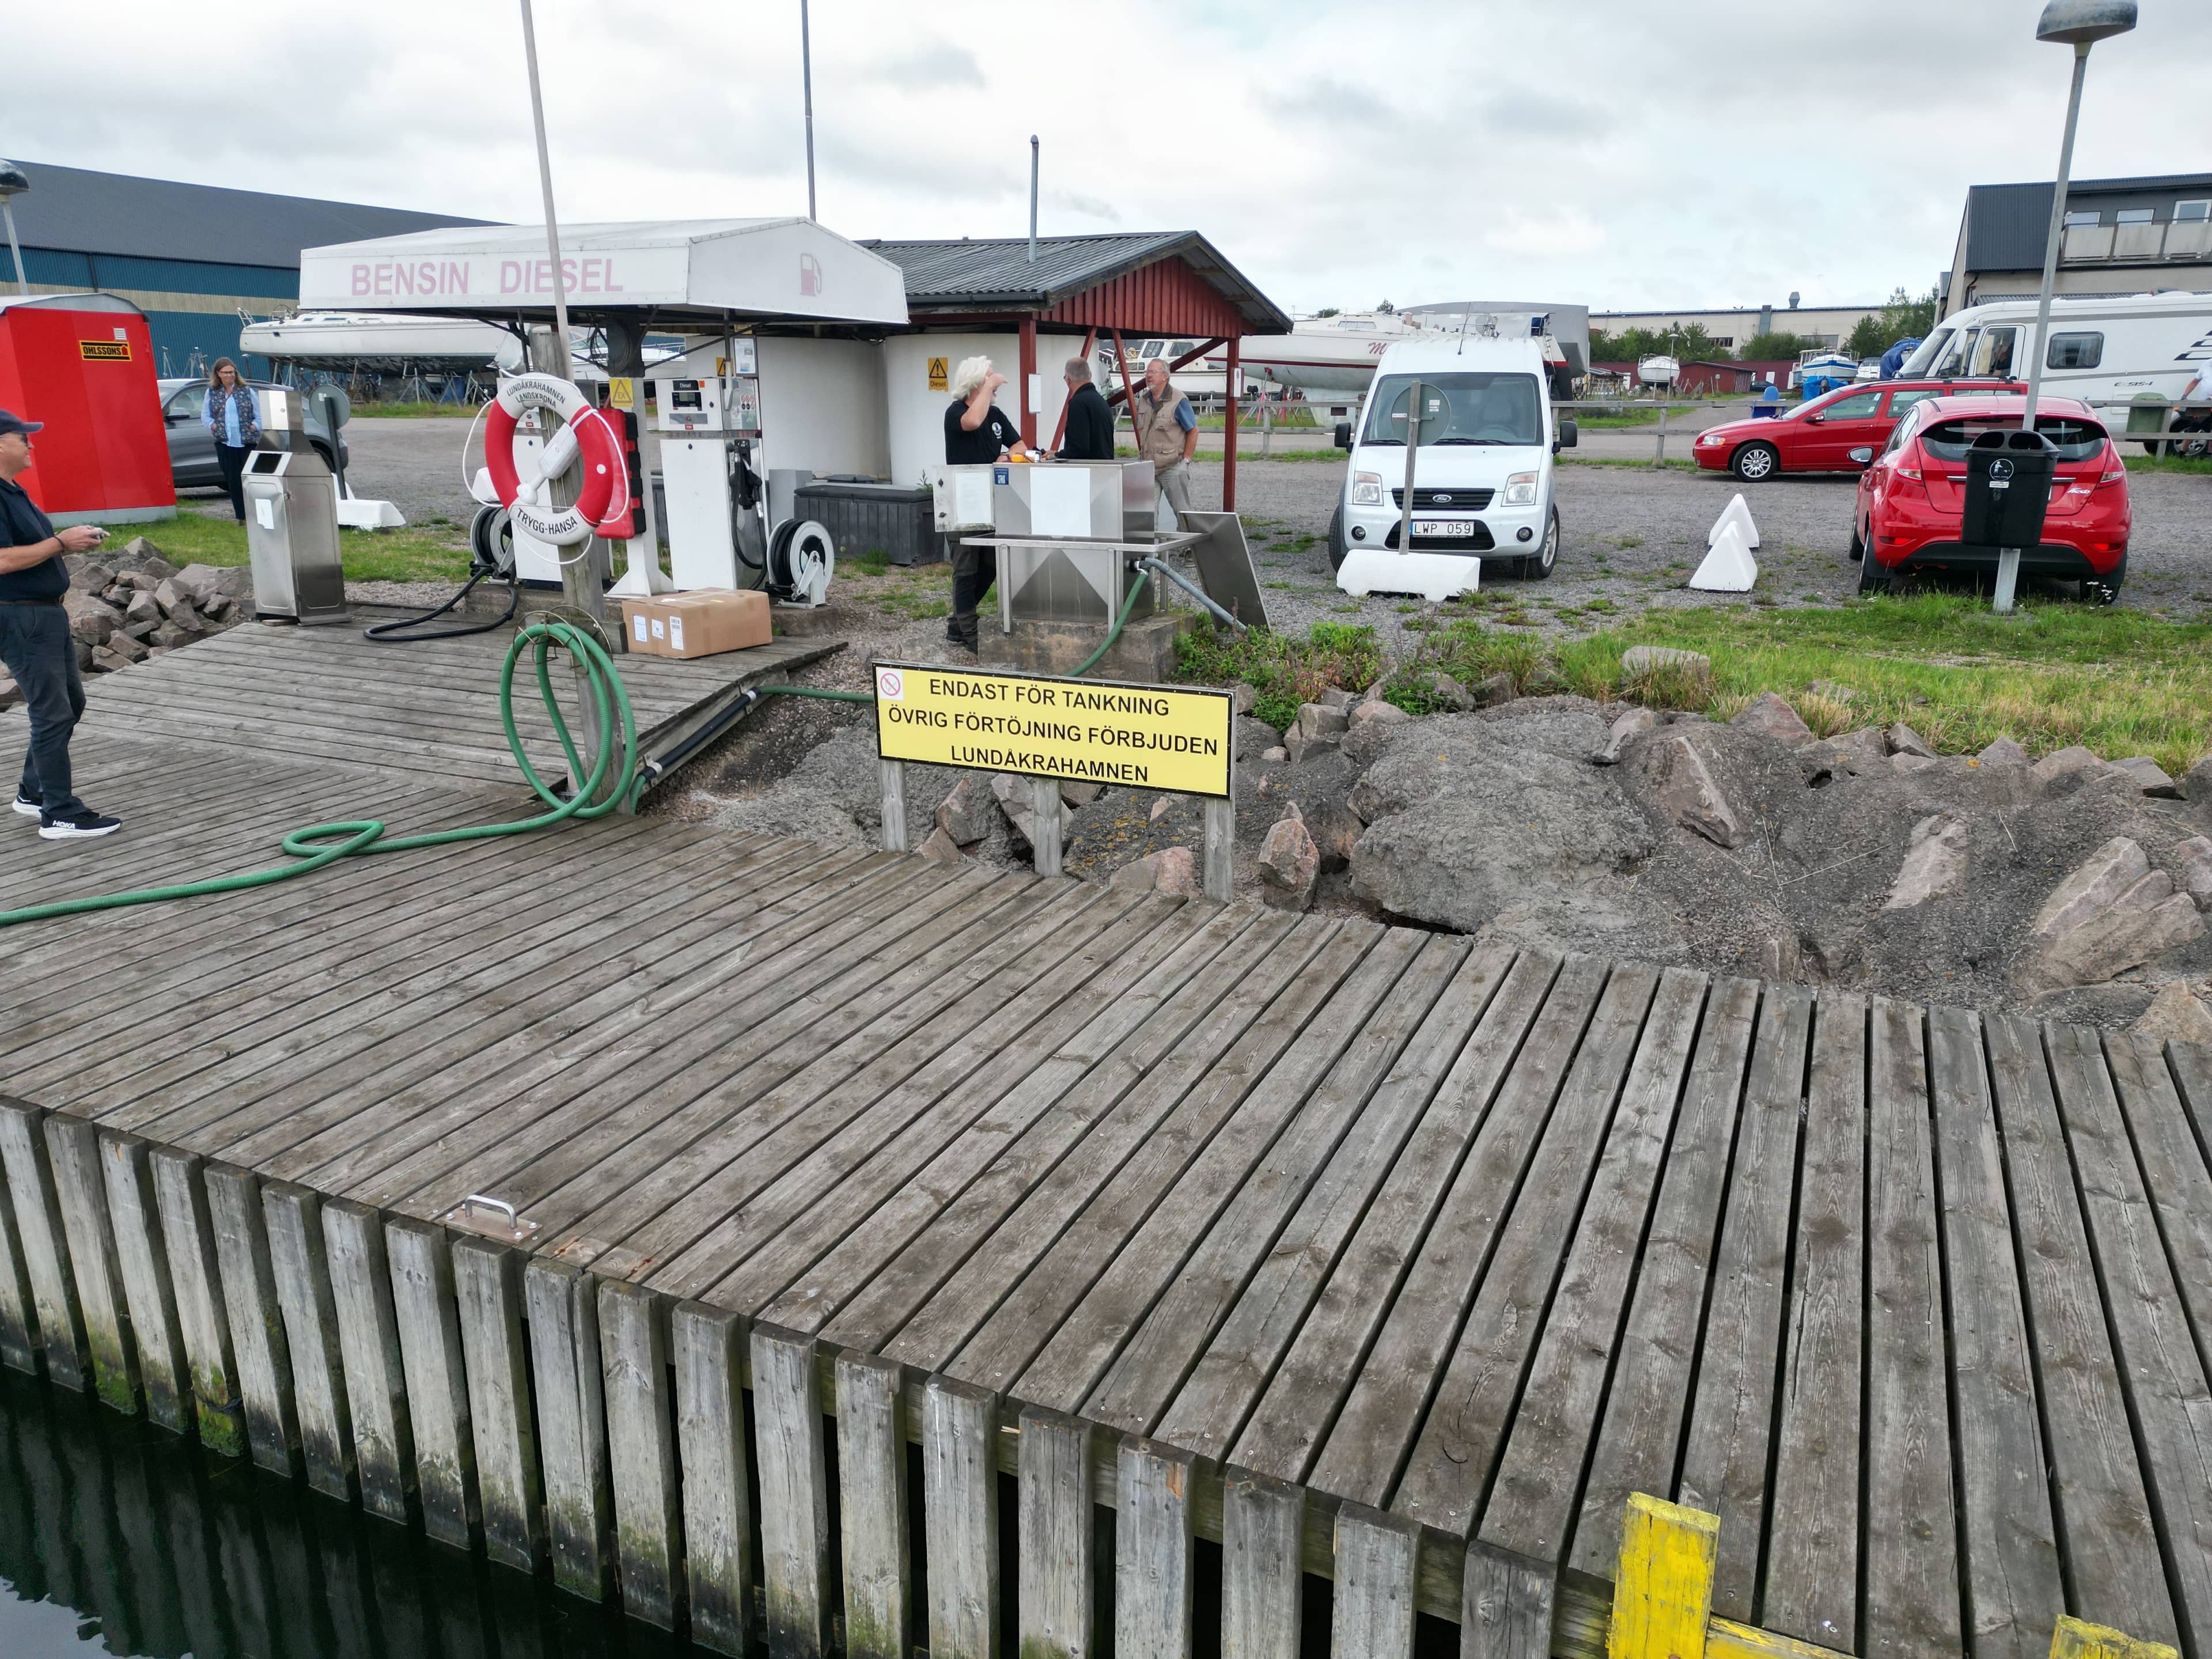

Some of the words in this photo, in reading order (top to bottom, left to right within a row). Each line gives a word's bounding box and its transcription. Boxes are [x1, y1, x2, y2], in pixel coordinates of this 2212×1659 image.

[351, 262, 469, 296] BENSIN
[499, 259, 624, 293] DIESEL
[83, 346, 121, 355] OHLSSONS
[507, 380, 565, 404] LUNDÅKRAHAMNEN
[516, 392, 556, 408] LANDSKRONA
[517, 507, 577, 535] TRYGG-HANSA
[1414, 523, 1438, 534] LWP
[1447, 523, 1471, 534] 059
[930, 679, 1009, 700] ENDAST
[1016, 684, 1056, 706] FÖR
[1062, 691, 1169, 716] TANKNING
[888, 704, 948, 728] ÖVRIG
[955, 712, 1081, 741] FÖRTÖJNING
[1089, 725, 1217, 756] FÖRBJUDEN
[951, 745, 1148, 782] LUNDÅKRAHAMNEN
[52, 820, 75, 829] HOKA
